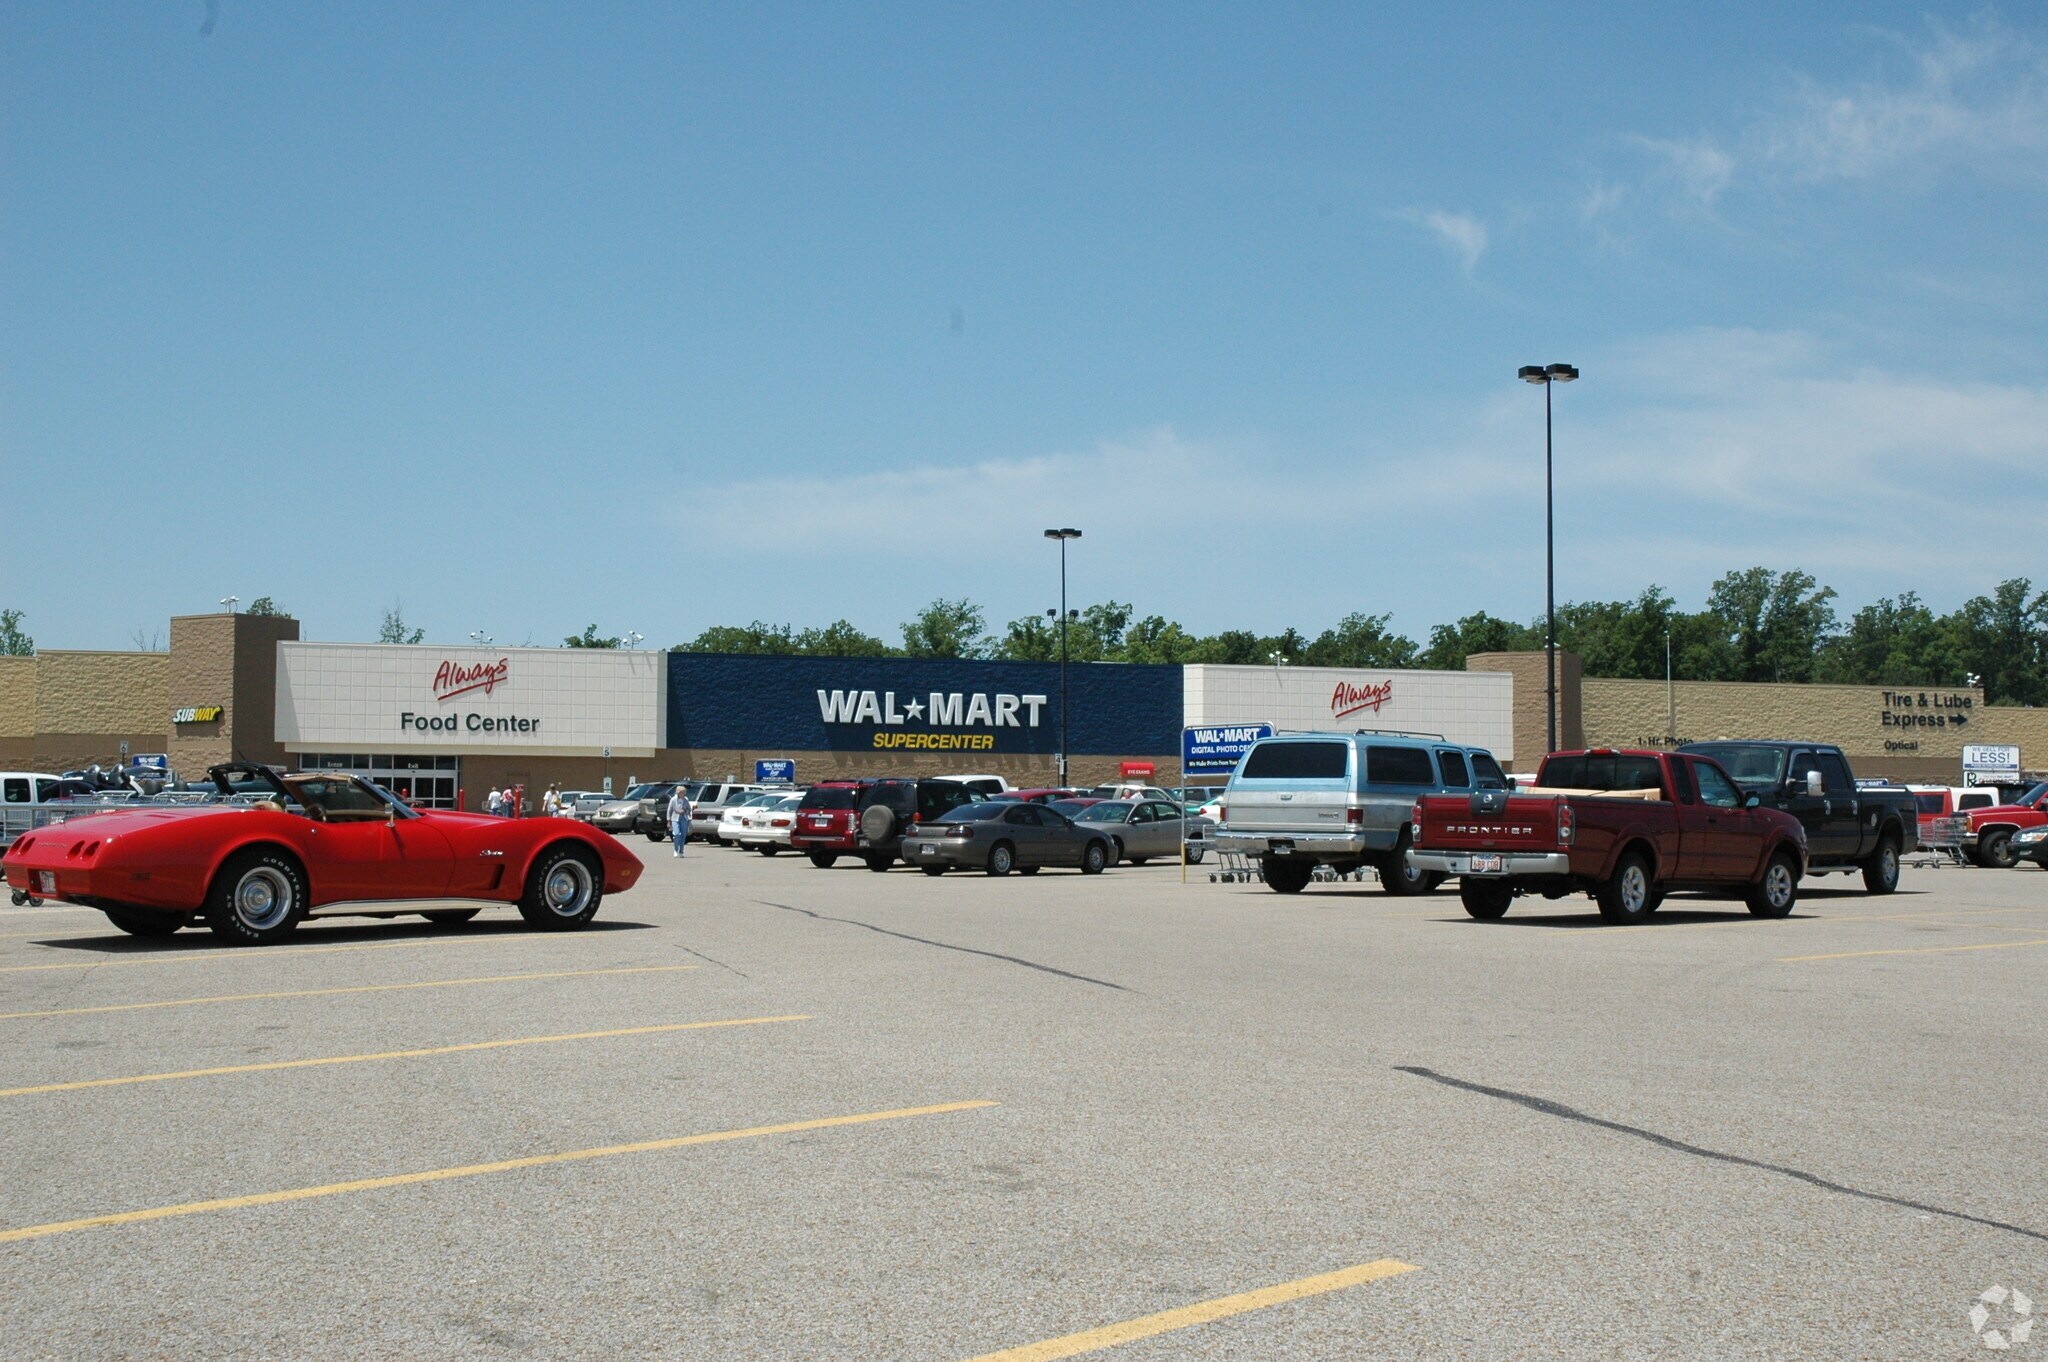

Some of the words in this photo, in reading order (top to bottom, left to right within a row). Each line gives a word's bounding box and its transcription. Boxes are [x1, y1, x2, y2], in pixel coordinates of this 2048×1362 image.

[432, 657, 508, 700] Always
[1331, 679, 1392, 718] Always
[1882, 691, 1912, 707] Tire
[1917, 692, 1928, 707] &
[1934, 693, 1972, 709] Lube
[172, 706, 221, 723] SUBWAY
[401, 712, 458, 731] Food
[465, 713, 540, 732] Center
[1882, 711, 1945, 729] Express
[872, 732, 994, 750] SUPERCENTER
[1191, 745, 1215, 754] DIGITAL
[1216, 744, 1238, 754] PHOTO
[1664, 736, 1694, 746] Photo
[1884, 740, 1918, 751] Optical
[1972, 753, 2010, 763] LESS!
[1446, 825, 1532, 834] FRONTIER
[263, 857, 301, 908] GOODYEAR
